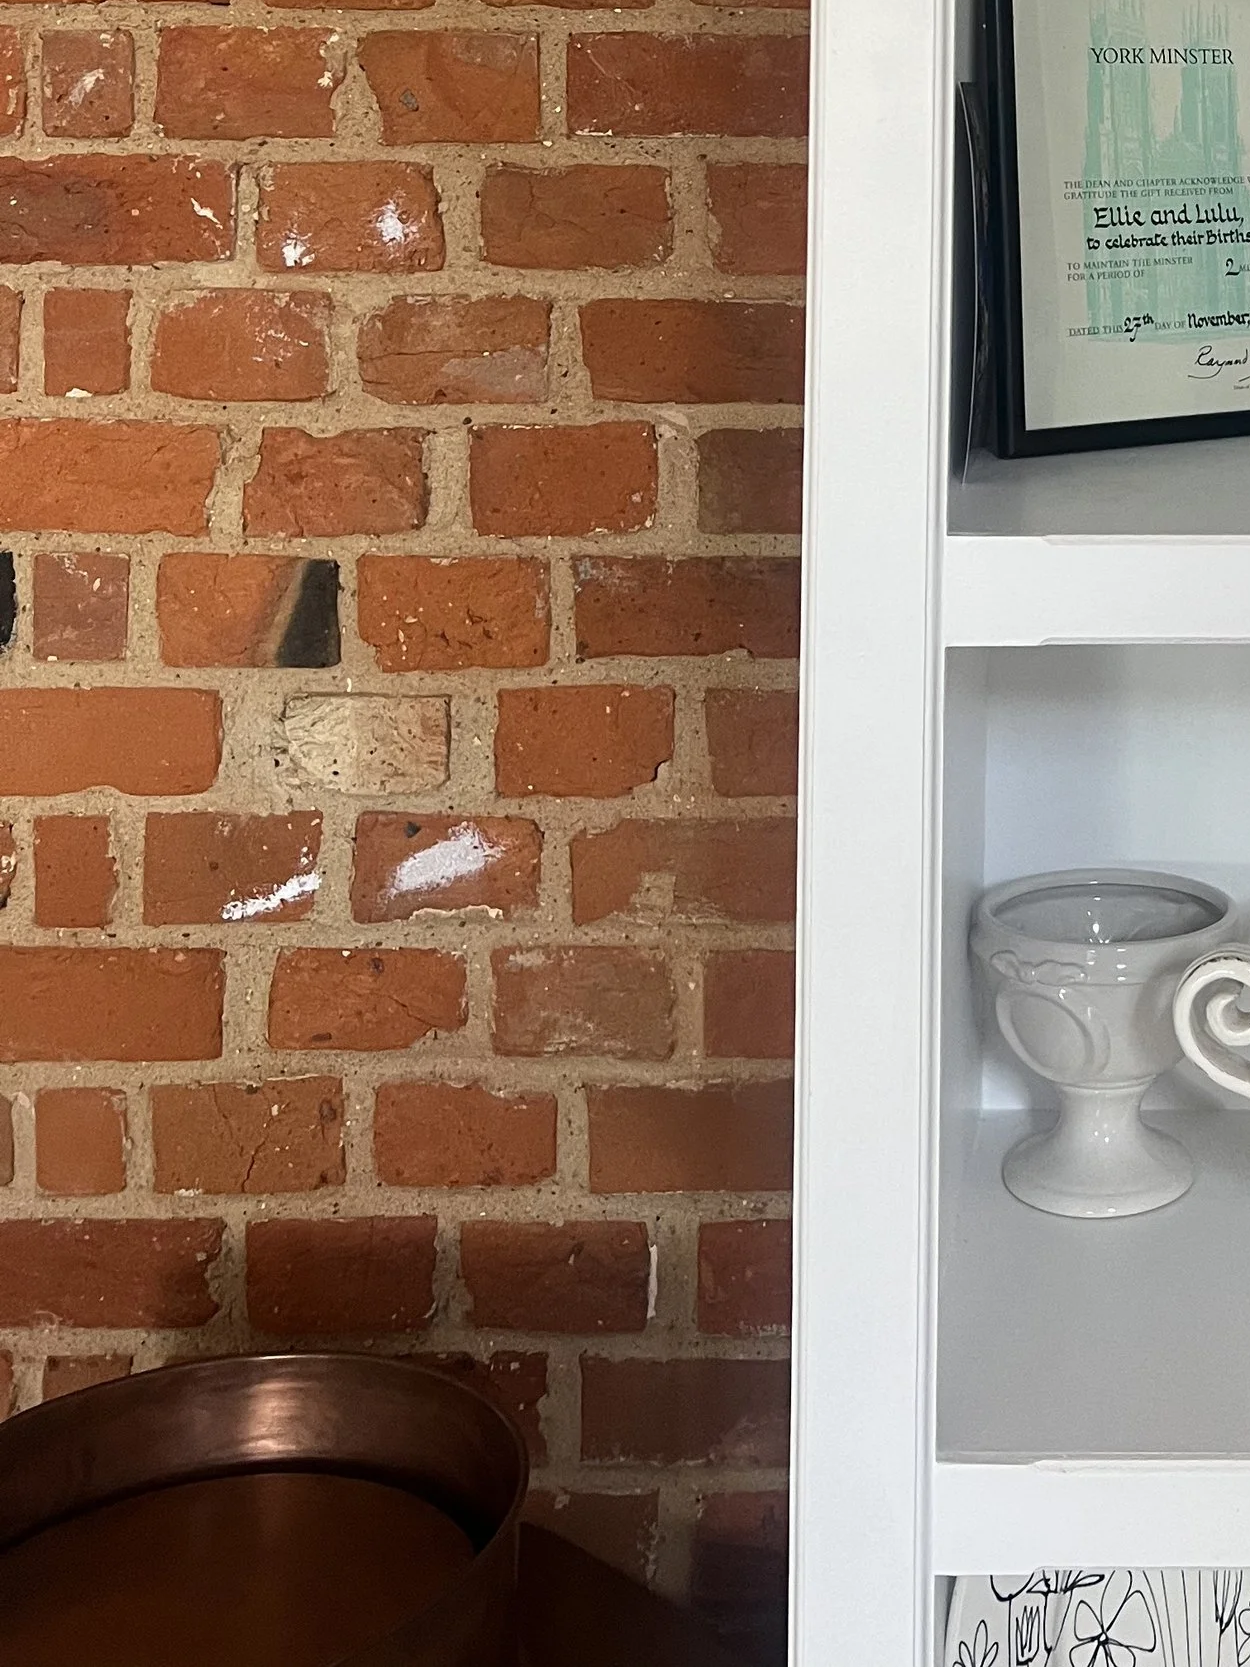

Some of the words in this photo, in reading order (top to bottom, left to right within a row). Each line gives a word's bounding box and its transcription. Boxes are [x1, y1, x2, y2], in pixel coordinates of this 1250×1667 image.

[1090, 47, 1145, 64] YORK
[1149, 47, 1234, 65] MINSTER
[1063, 181, 1082, 190] THE
[1085, 180, 1111, 189] DEAN
[1113, 179, 1134, 188] AND
[1136, 177, 1177, 187] CHAPTER
[1179, 175, 1245, 186] ACKNOWLEDGE
[1063, 190, 1117, 200] GRATITUDE
[1120, 189, 1138, 199] THE
[1140, 188, 1161, 198] GIFT
[1164, 187, 1206, 197] RECEIVED
[1208, 186, 1234, 195] FROM
[1093, 205, 1146, 229] Ellie
[1150, 202, 1192, 226] and
[1195, 202, 1244, 228] Lulu,
[1086, 236, 1101, 250] to
[1105, 233, 1169, 250] celebrate
[1171, 230, 1204, 246] their
[1067, 262, 1081, 271] TO
[1083, 259, 1130, 270] MAINTAIN
[1132, 258, 1151, 267] THE
[1153, 256, 1193, 267] MINSTER
[1225, 258, 1240, 276] 2
[1067, 272, 1086, 282] FOR
[1088, 272, 1095, 280] A
[1097, 270, 1131, 281] PERIOD
[1133, 269, 1145, 278] OF
[1068, 326, 1100, 337] DATED
[1102, 325, 1123, 334] THIS
[1154, 321, 1172, 330] DAY
[1173, 320, 1186, 329] OF
[1187, 310, 1250, 328] November,
